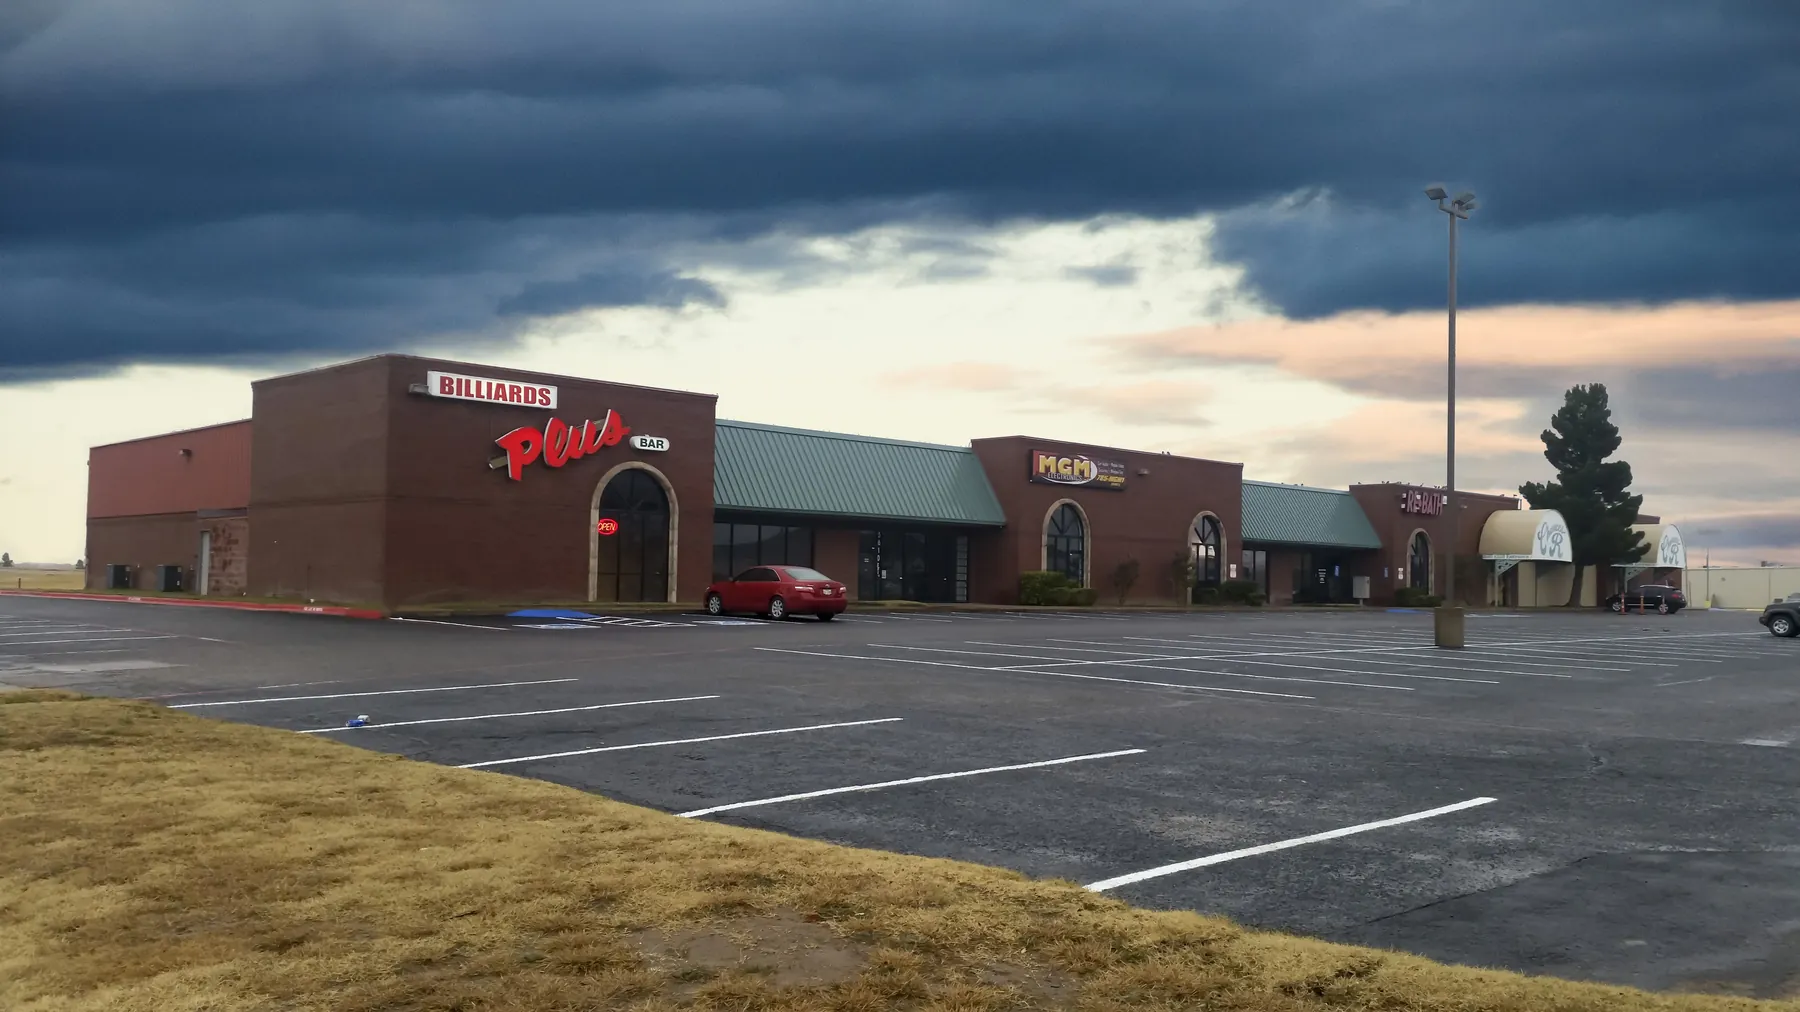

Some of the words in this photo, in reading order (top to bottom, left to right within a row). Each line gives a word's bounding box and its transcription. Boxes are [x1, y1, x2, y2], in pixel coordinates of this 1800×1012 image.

[440, 376, 551, 406] BILLIARDS
[495, 408, 631, 481] Plus
[639, 438, 664, 449] BAR
[1039, 454, 1090, 478] MGM
[1047, 472, 1083, 481] ELECTRONICS
[598, 522, 616, 531] OPEN
